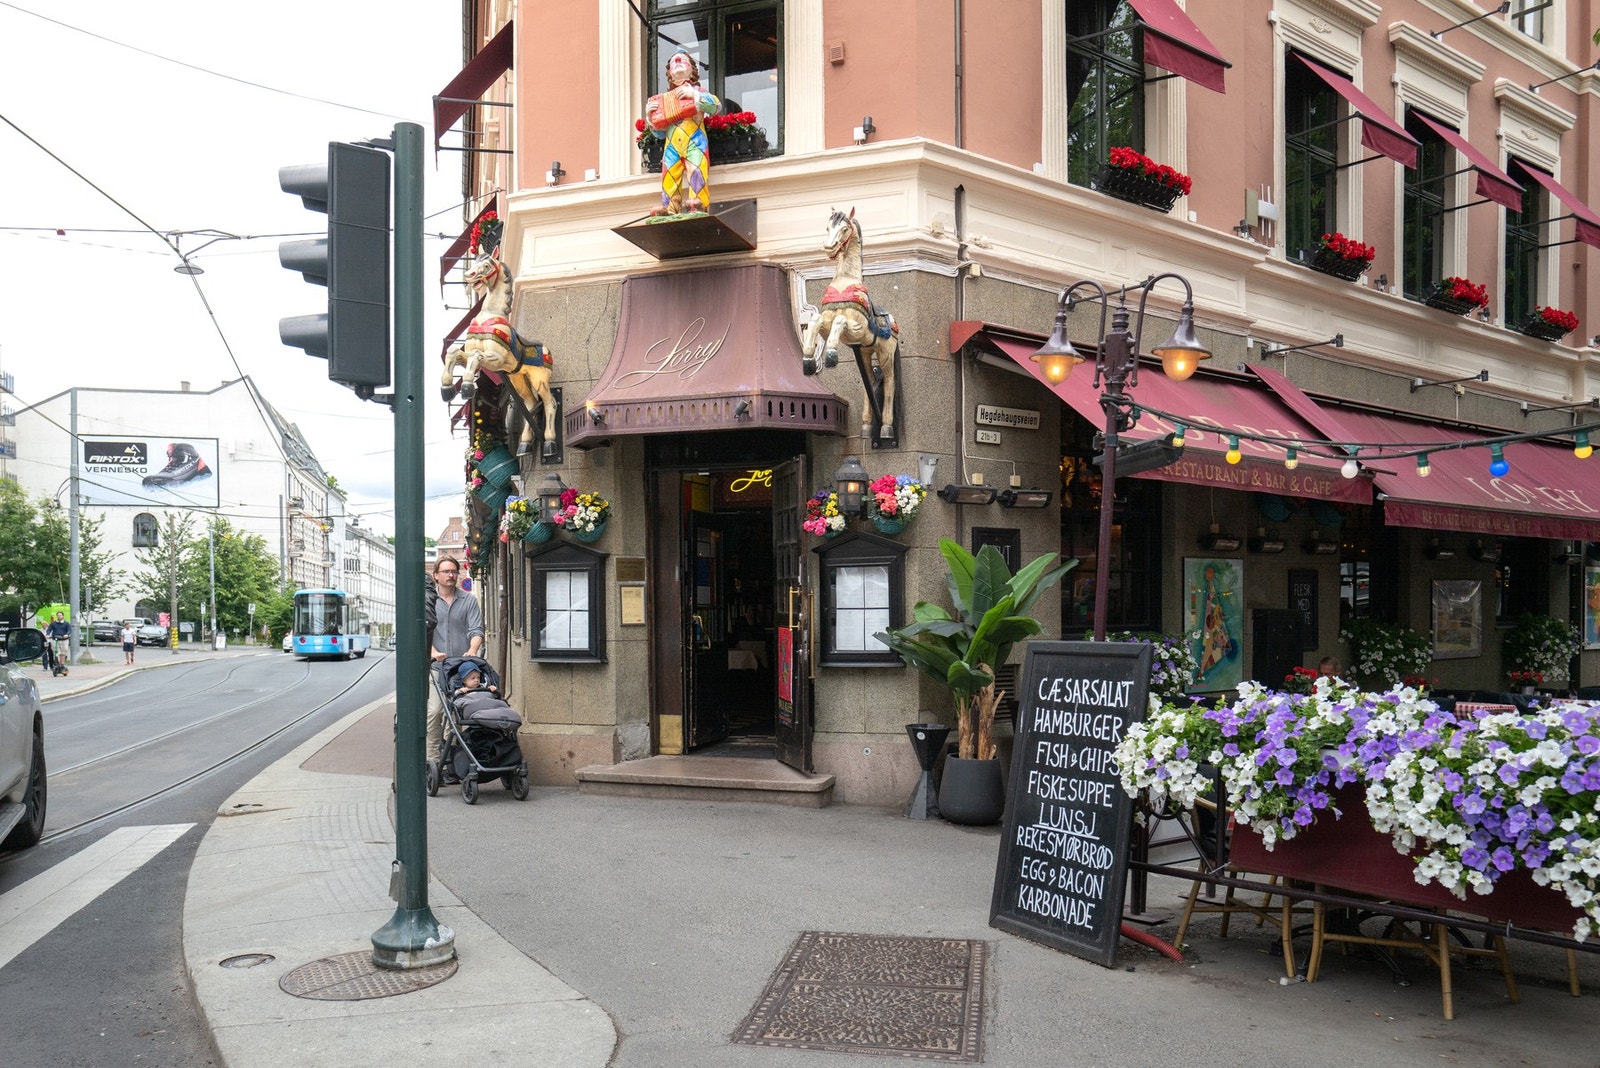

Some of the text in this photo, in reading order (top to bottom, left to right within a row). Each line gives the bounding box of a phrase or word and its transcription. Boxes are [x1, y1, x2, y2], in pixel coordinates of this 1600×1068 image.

[613, 317, 732, 389] Lorry
[980, 408, 1038, 426] Hegdehaugsveien
[85, 466, 147, 474] VERNESKO
[1164, 461, 1247, 484] RESTAURANT
[1251, 470, 1262, 486] &
[1265, 472, 1286, 490] BAR
[1290, 476, 1300, 492] &
[1038, 677, 1134, 708] CÆSARSALAT
[1033, 707, 1123, 742] HAMBURGER
[1035, 741, 1069, 769] FISH
[1079, 746, 1120, 776] CHIPS
[1027, 770, 1115, 808] FISKESUPPE
[1038, 802, 1096, 836] LUNSJ
[1016, 825, 1114, 870] REKESMØRBRØD
[1021, 856, 1048, 882] EGG
[1058, 866, 1105, 900] BACON
[1018, 884, 1096, 931] KARBONADE
